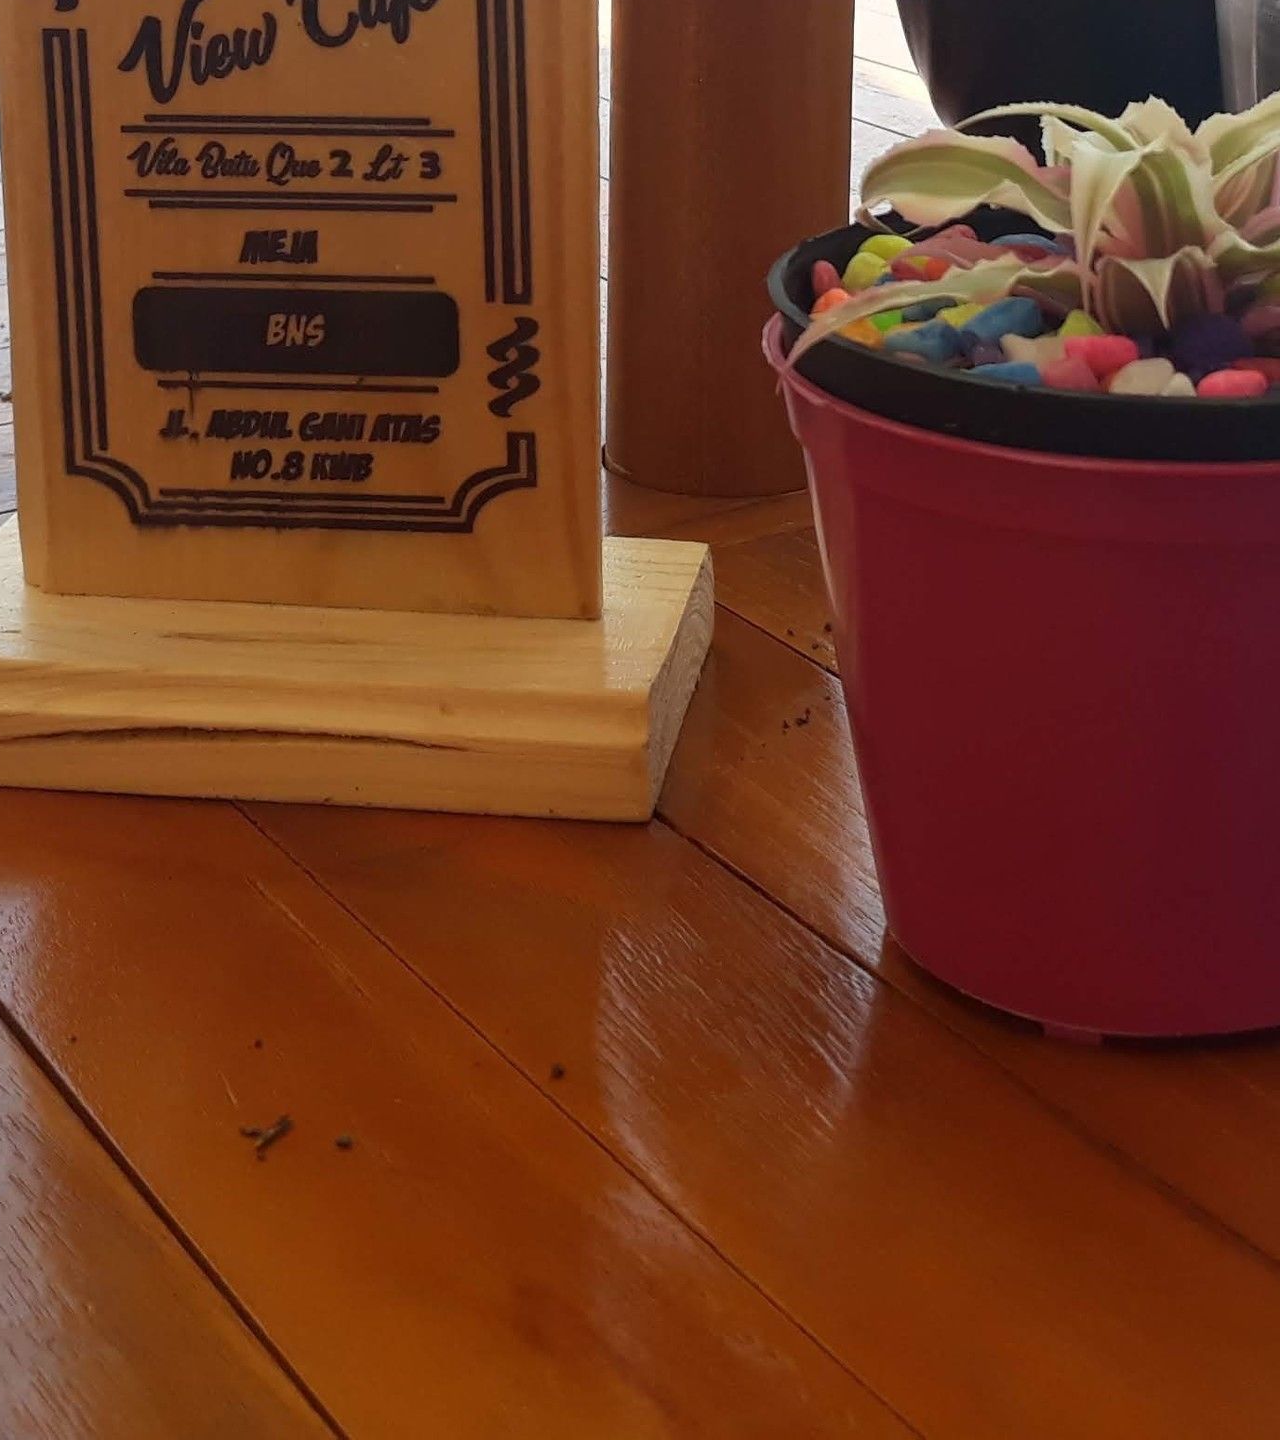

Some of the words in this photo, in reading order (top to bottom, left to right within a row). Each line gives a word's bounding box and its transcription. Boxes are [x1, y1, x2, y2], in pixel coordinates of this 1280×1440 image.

[329, 150, 353, 177] 2
[419, 150, 442, 179] 3
[266, 313, 325, 346] BNS
